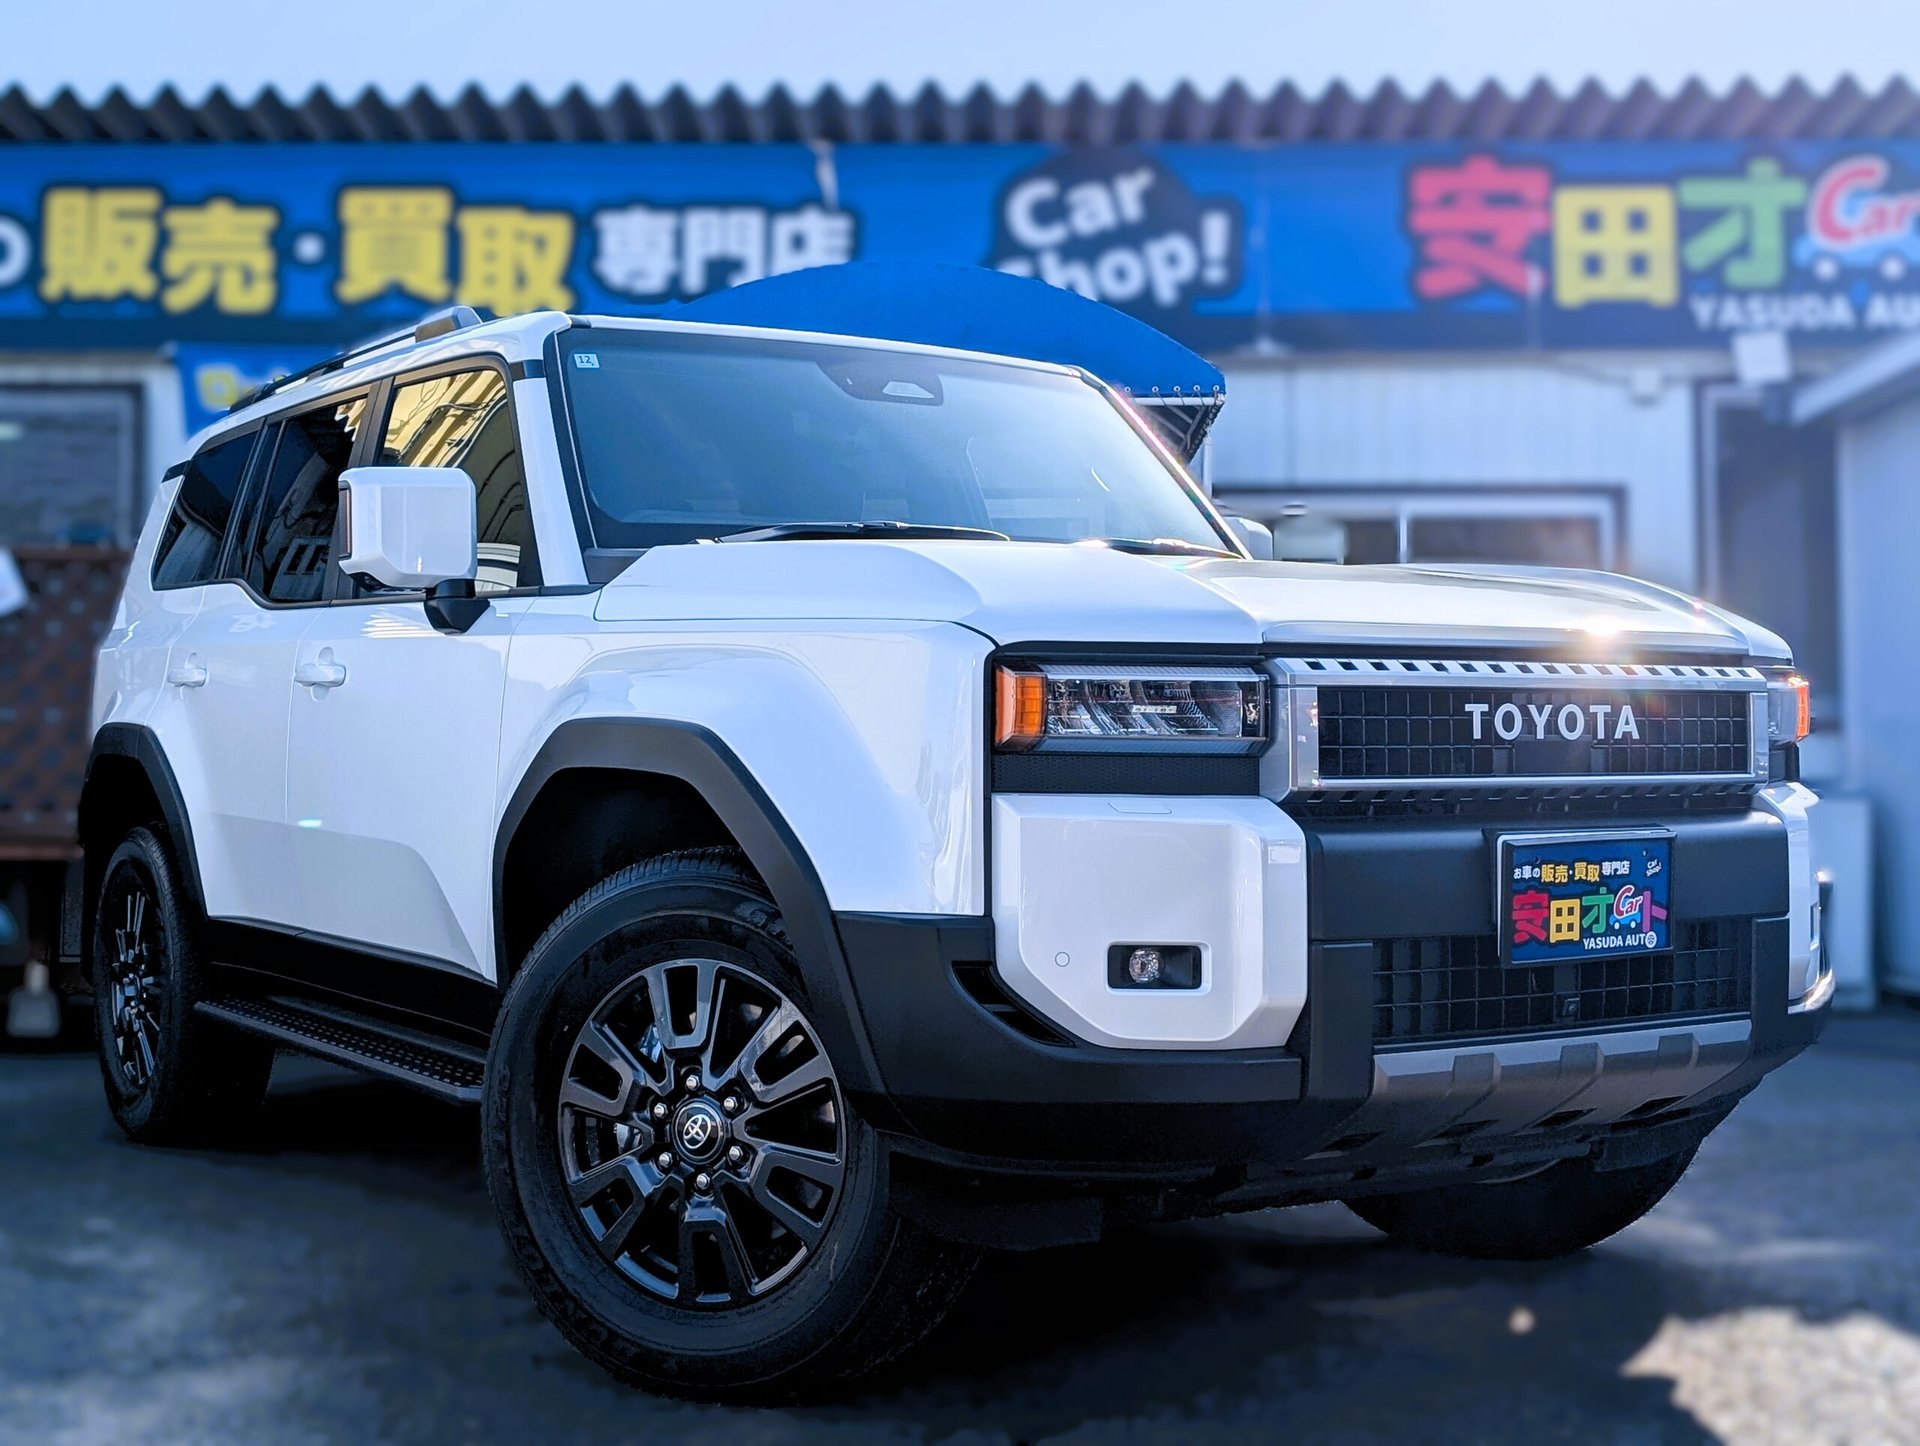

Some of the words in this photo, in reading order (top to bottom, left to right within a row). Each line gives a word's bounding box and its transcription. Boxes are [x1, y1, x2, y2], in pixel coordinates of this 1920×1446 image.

[1006, 169, 1155, 248] Car
[1689, 293, 1858, 329] YASUDA
[1464, 703, 1640, 741] TOYOTA
[1582, 935, 1624, 951] YASUDA
[1624, 930, 1658, 949] AUTO
